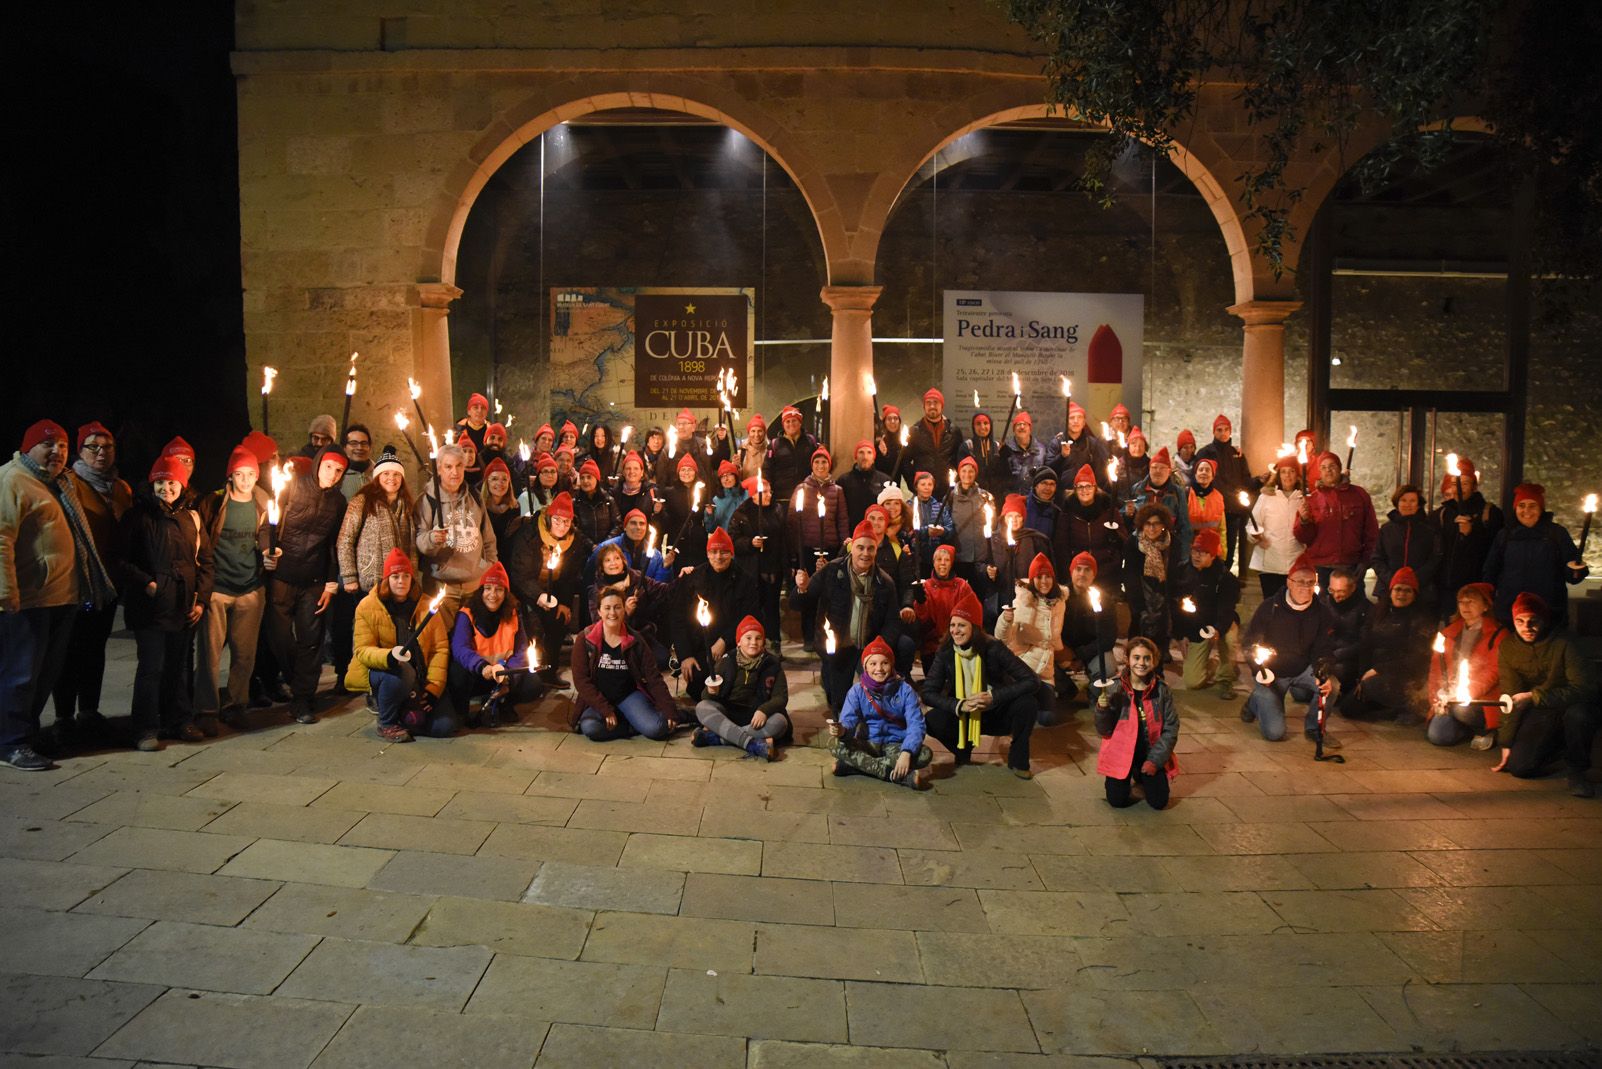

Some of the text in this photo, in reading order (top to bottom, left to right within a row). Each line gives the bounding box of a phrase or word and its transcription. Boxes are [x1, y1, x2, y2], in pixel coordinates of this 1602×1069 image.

[957, 319, 1079, 344] Pedra i Sang
[645, 330, 736, 359] CUBA
[678, 361, 706, 373] 1898
[687, 374, 703, 382] NOVA
